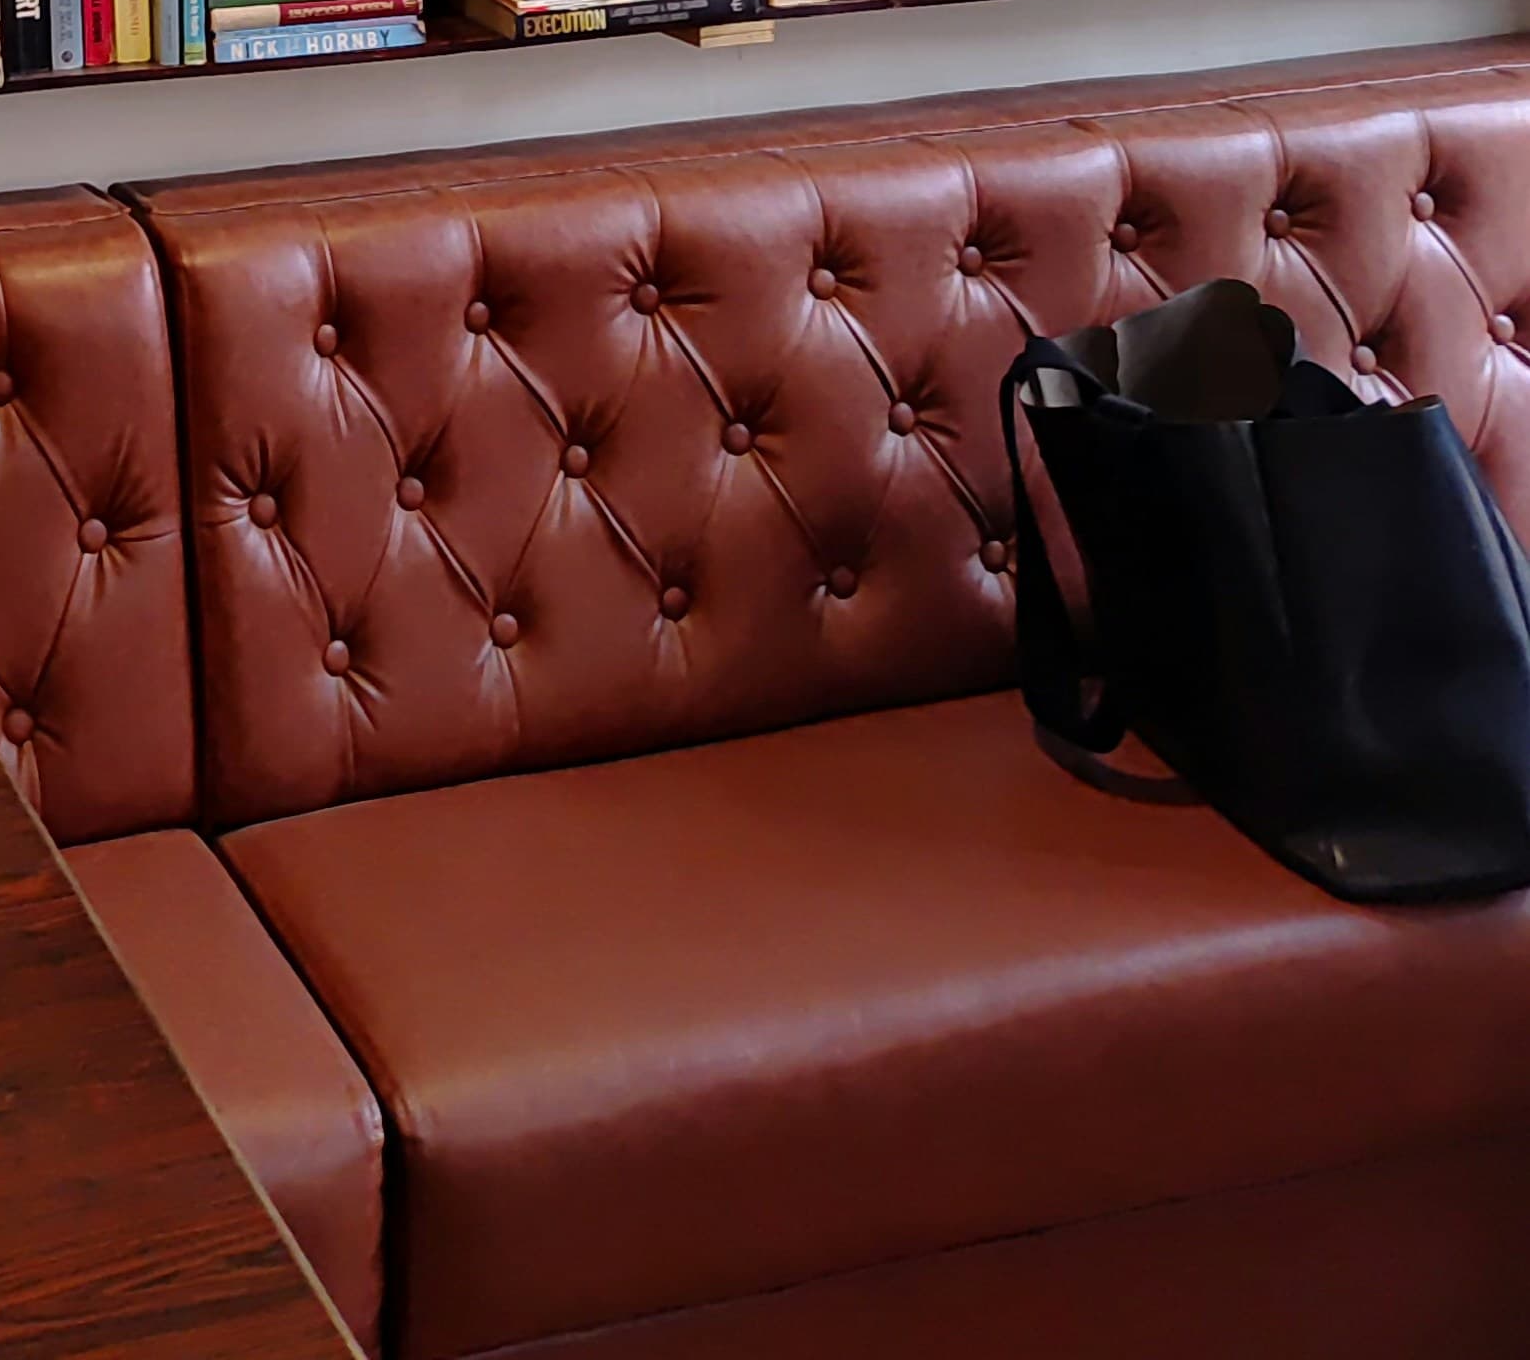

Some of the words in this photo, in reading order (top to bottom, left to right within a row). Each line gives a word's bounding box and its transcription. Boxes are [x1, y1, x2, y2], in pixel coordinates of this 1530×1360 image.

[522, 8, 608, 38] EXECUTION
[229, 39, 279, 60] NICK
[305, 28, 391, 53] HORNBY
